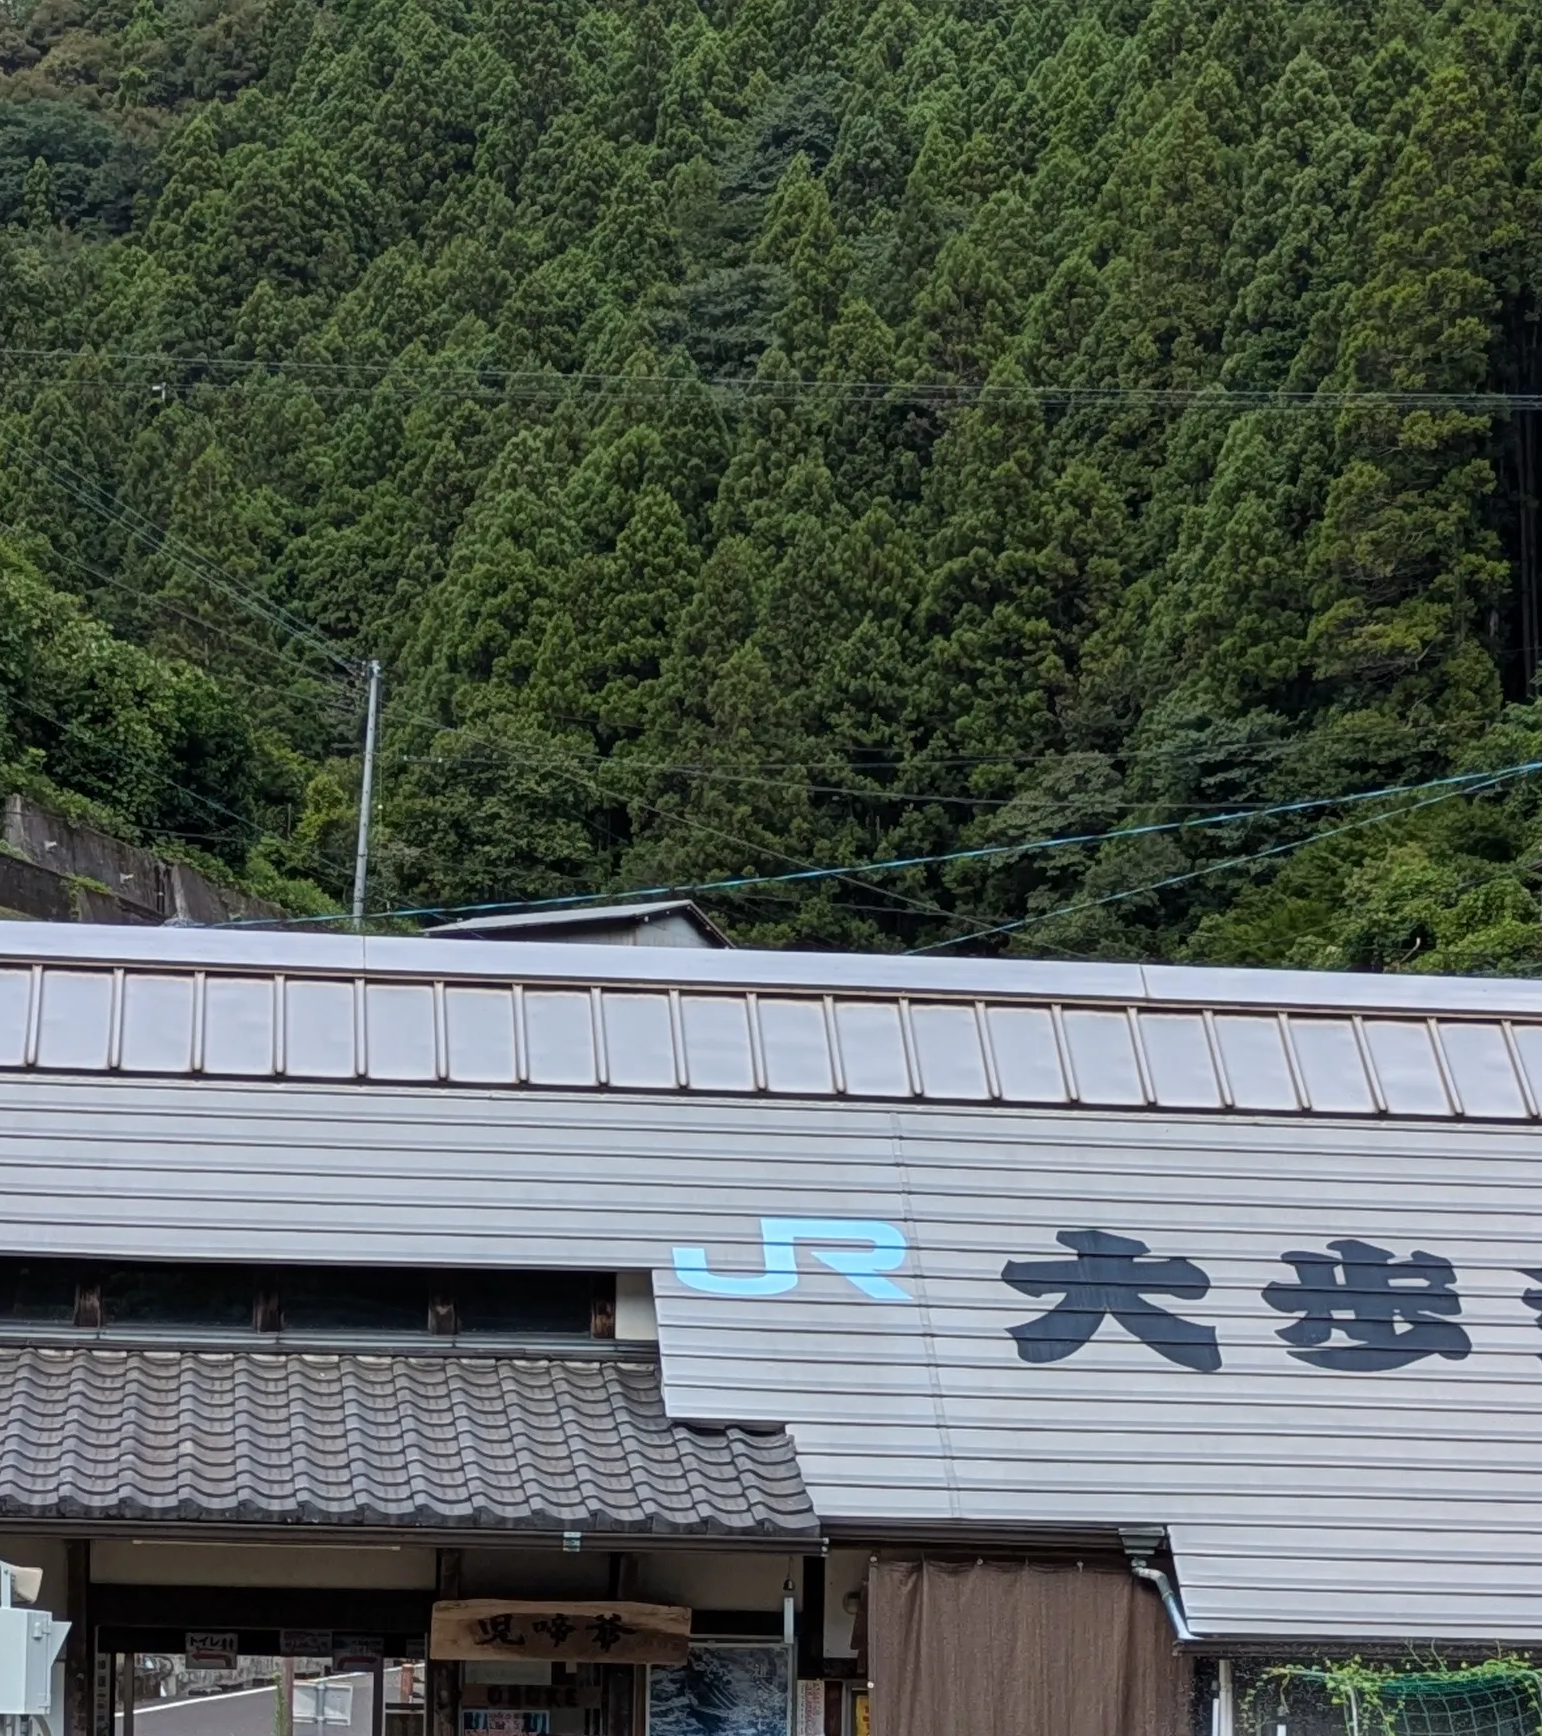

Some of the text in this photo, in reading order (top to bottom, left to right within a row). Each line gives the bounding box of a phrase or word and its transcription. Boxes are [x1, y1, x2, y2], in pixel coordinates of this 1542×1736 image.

[673, 1215, 913, 1303] JR
[189, 1635, 221, 1648] トイレ
[474, 1612, 637, 1653] 児啼爺
